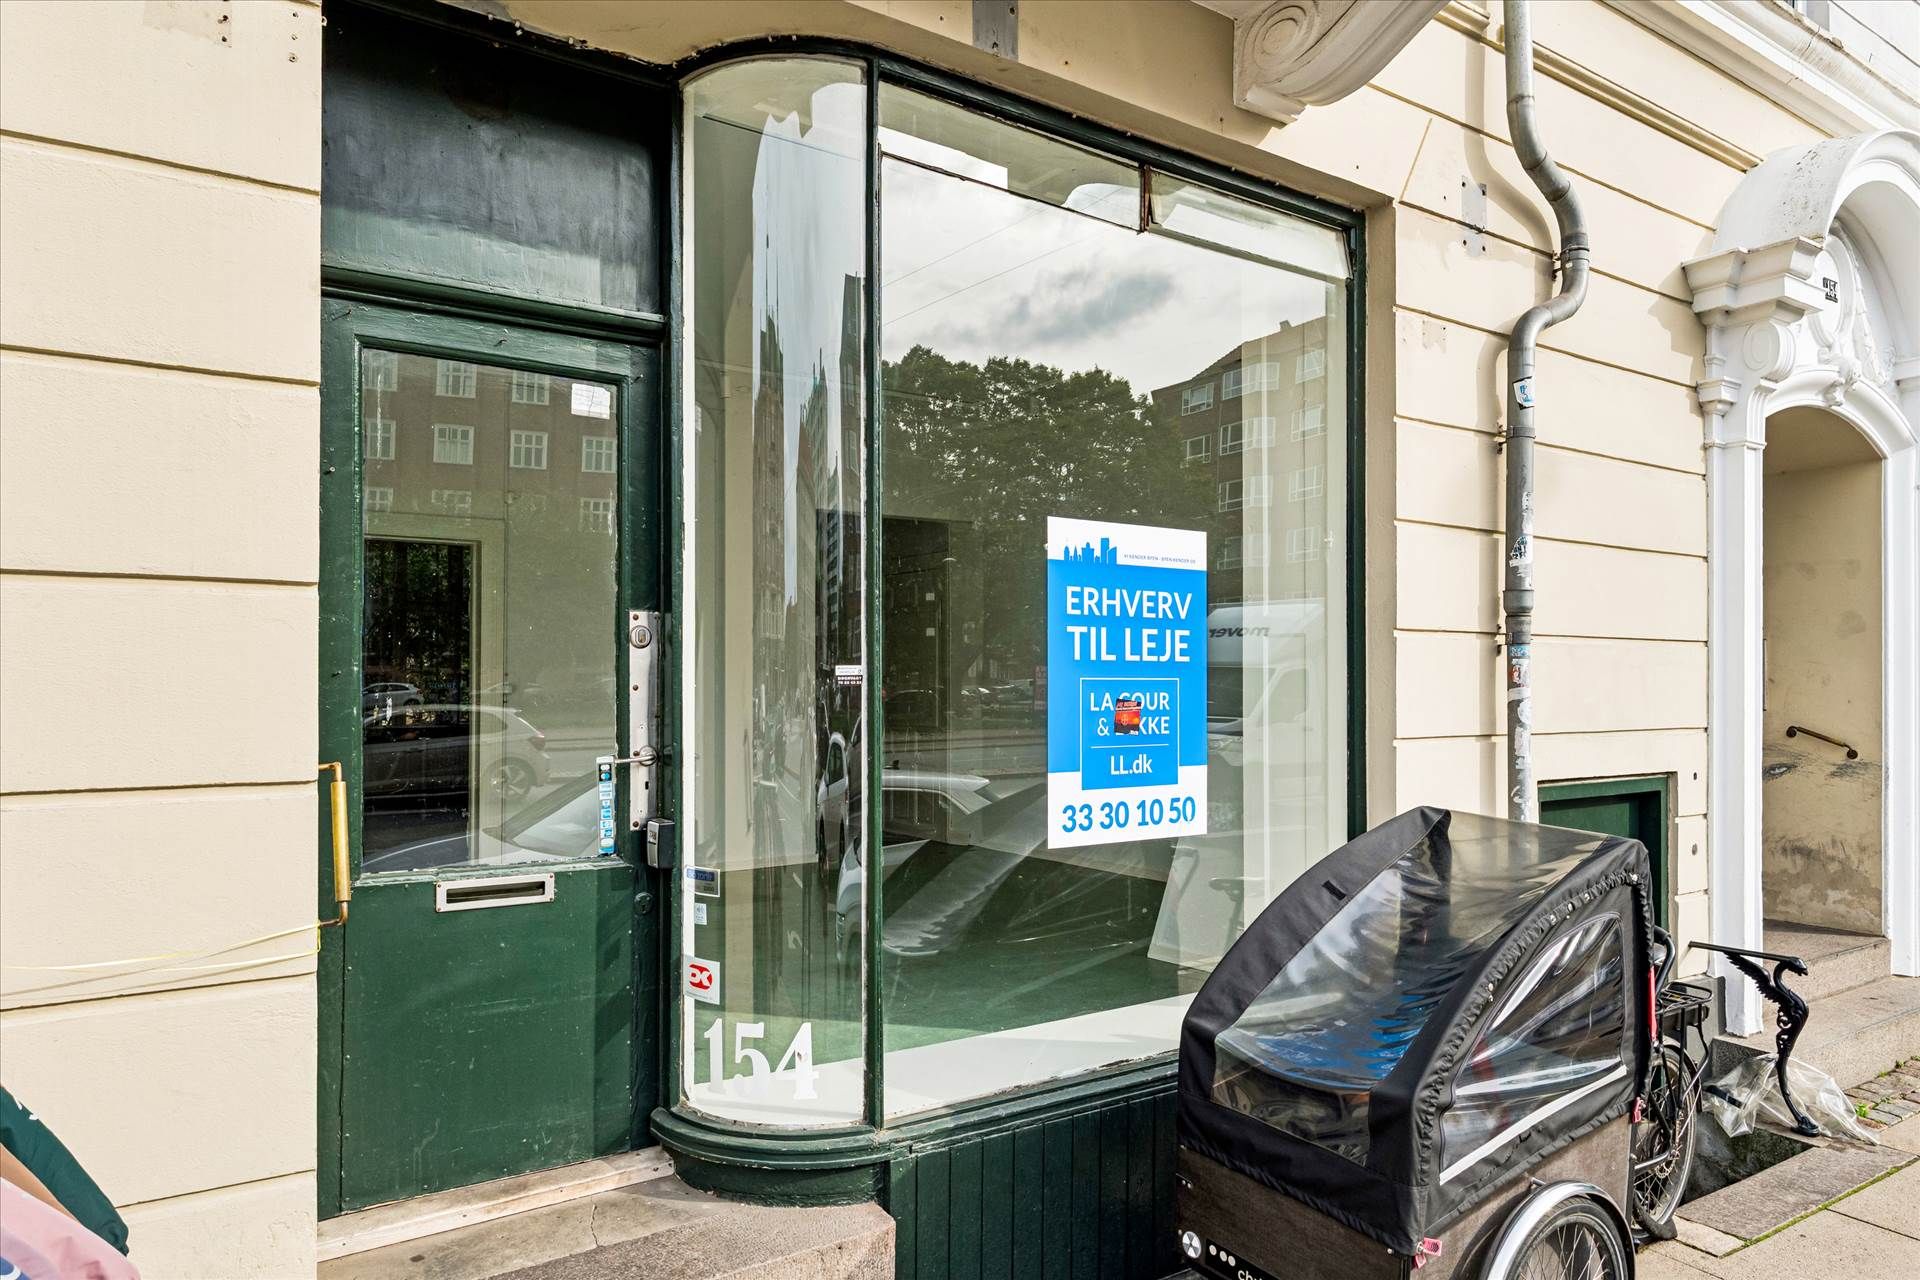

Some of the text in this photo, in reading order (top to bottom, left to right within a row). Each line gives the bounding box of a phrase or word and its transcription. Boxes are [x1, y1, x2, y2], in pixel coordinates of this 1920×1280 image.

[1066, 586, 1192, 619] ERHVERV
[1066, 625, 1190, 662] TIL LEJE
[1090, 692, 1113, 711] LA
[1097, 716, 1170, 737] & KKE
[1110, 753, 1152, 775] LL.dk
[1062, 796, 1196, 833] 33 30 10 50
[703, 1018, 819, 1100] 154
